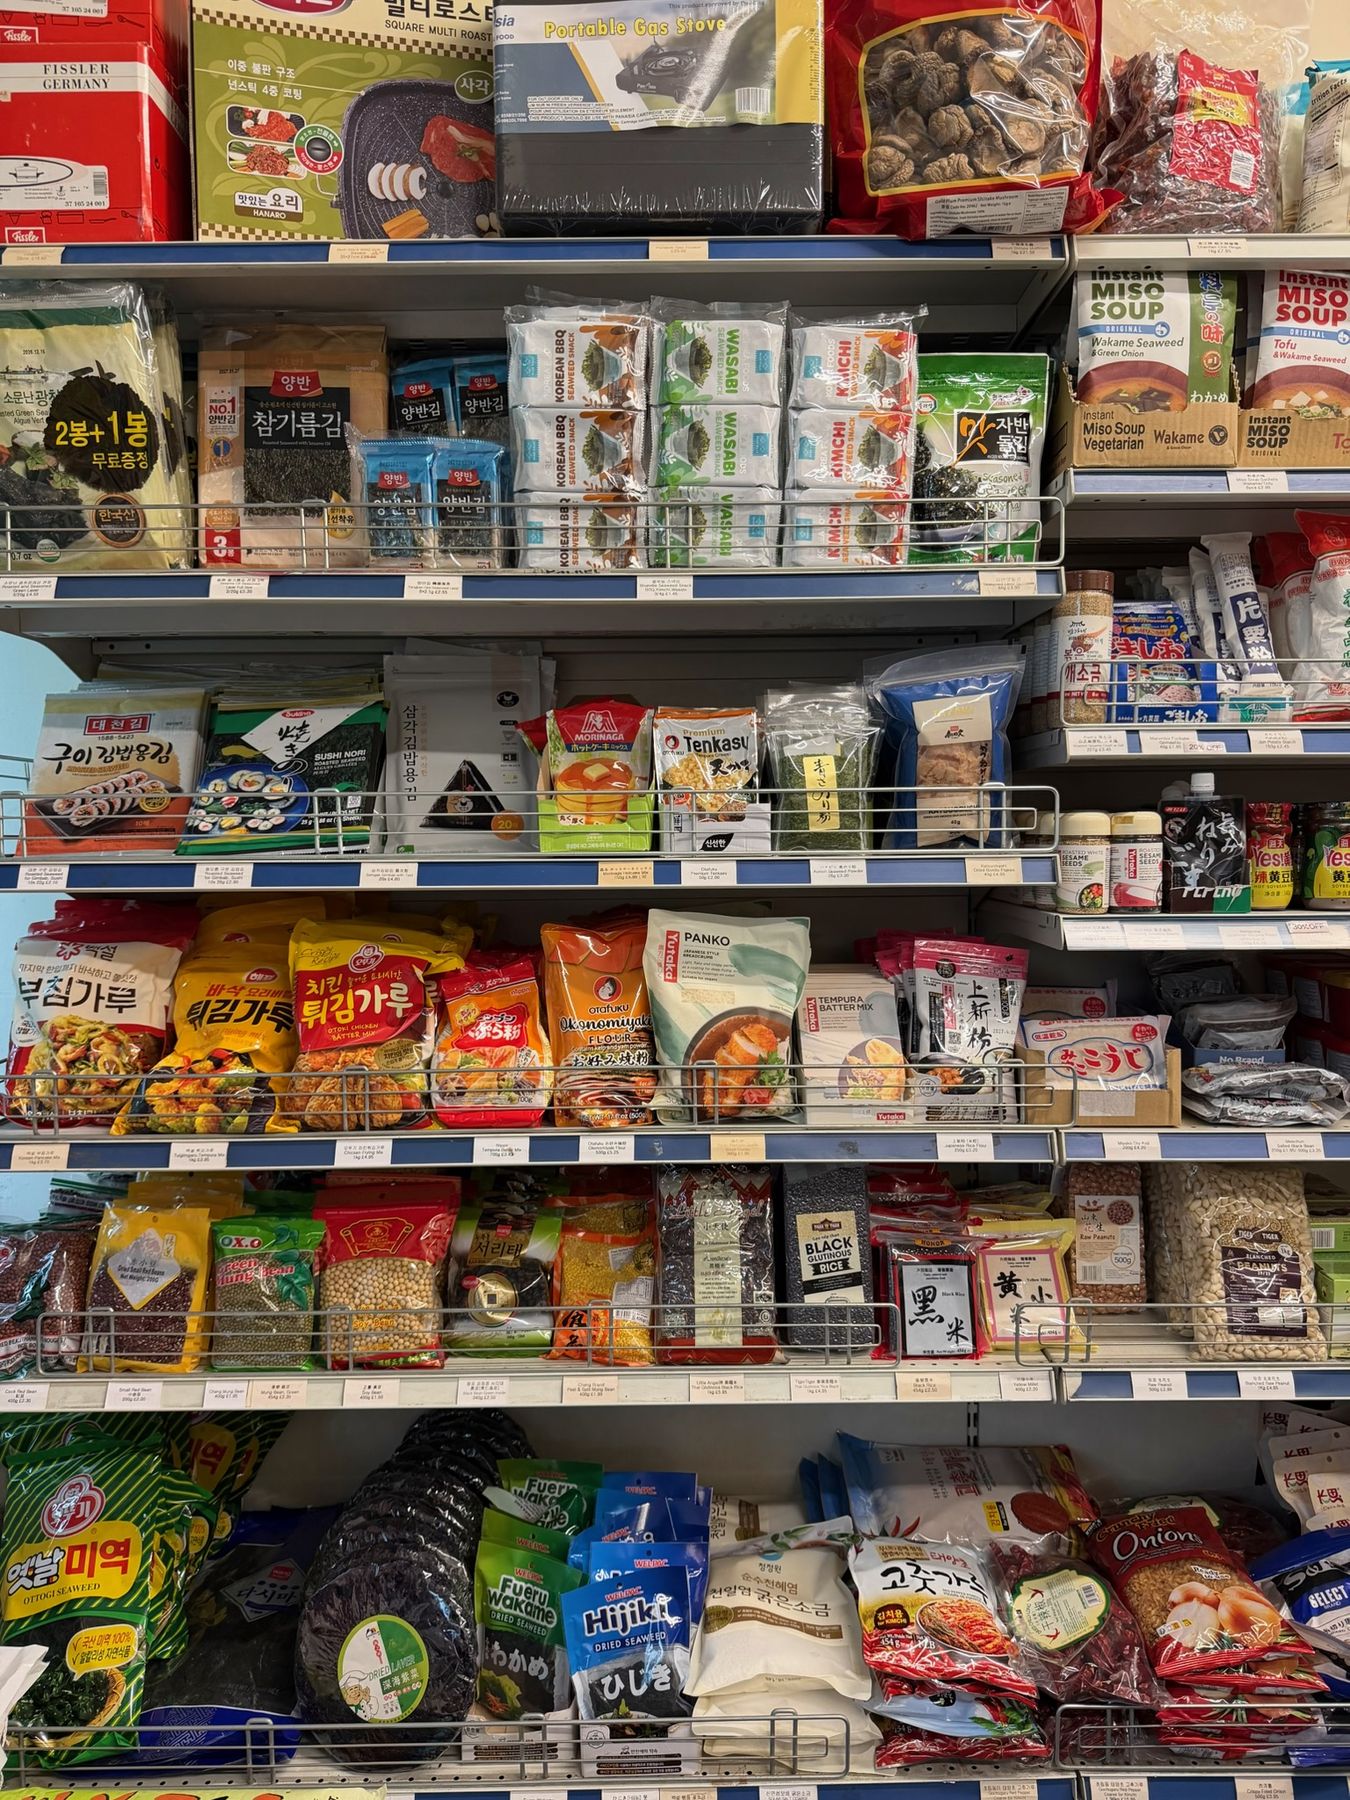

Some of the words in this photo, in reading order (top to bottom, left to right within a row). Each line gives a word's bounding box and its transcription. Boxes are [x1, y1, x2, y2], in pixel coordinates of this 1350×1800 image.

[4, 29, 32, 42] Fissler
[384, 20, 424, 33] SQUARE
[429, 26, 457, 38] MULTI
[544, 17, 627, 39] Portable
[634, 17, 669, 36] Gas
[676, 17, 726, 35] Stove
[43, 63, 110, 75] FISSLER
[228, 58, 247, 72] 이중
[252, 61, 272, 76] 불판
[276, 65, 296, 79] 구조
[42, 78, 111, 91] GERMANY
[228, 79, 258, 94] 넌스틱
[262, 83, 280, 98] 4중
[460, 78, 490, 95] 사각
[237, 194, 268, 209] 맛있는
[269, 192, 299, 211] 요리
[252, 208, 287, 220] HANARO
[12, 231, 40, 243] Fissler
[1279, 269, 1349, 289] Instant
[1091, 282, 1165, 301] MISO
[1278, 284, 1349, 308] MISO
[1090, 302, 1164, 320] SOUP
[1275, 306, 1347, 327] SOUP
[1105, 325, 1142, 333] ORIGINAL
[555, 329, 566, 355] BBQ
[1092, 336, 1134, 348] Wakame
[1136, 336, 1184, 348] Seaweed
[1273, 338, 1297, 350] Tofu
[725, 328, 740, 395] WASABI
[1120, 349, 1144, 358] Onion
[281, 375, 311, 392] 양반
[474, 376, 491, 388] 양반
[555, 358, 565, 403] KOREAN
[409, 384, 426, 395] 양반
[208, 398, 237, 415] NO.1
[402, 401, 441, 421] 양반김
[464, 394, 504, 414] 양반김
[208, 415, 236, 425] 양반김
[251, 409, 342, 438] 참기름김
[1083, 410, 1114, 421] Instant
[1249, 415, 1292, 425] Instant
[555, 414, 567, 440] BBQ
[996, 415, 1029, 434] 자반
[1083, 422, 1113, 435] Miso
[1114, 423, 1146, 438] Soup
[1247, 425, 1291, 437] MISO
[723, 412, 738, 477] WASABI
[1083, 437, 1145, 452] Vegetarian
[1153, 429, 1205, 445] Wakame
[1246, 436, 1289, 449] SOUP
[830, 421, 847, 478] KIMCHI
[92, 452, 149, 470] 무료증정
[556, 441, 567, 488] KOREAN
[384, 473, 403, 484] 양반
[454, 469, 473, 482] 양반
[98, 509, 137, 523] 한국산
[92, 715, 144, 731] 대천김
[574, 732, 625, 742] MORINAGA
[683, 736, 749, 754] Tenkasu
[42, 742, 92, 775] 구이
[96, 742, 174, 764] 김밥용김
[314, 751, 341, 761] SUSHI
[343, 749, 367, 759] NORI
[705, 838, 727, 849] 신선한
[1062, 854, 1089, 862] SESAME
[1127, 848, 1137, 878] Yutaka
[684, 931, 731, 947] PANKO
[664, 930, 681, 983] Yutaka
[17, 975, 138, 1014] 부침가루
[818, 996, 865, 1005] TEMPURA
[300, 982, 414, 1029] 튀김가루
[819, 1003, 856, 1012] BATTER
[857, 1003, 874, 1012] MIX
[806, 996, 820, 1033] Yutaka
[331, 1032, 361, 1041] BATTER
[362, 1030, 376, 1038] MIX
[588, 1034, 633, 1044] FLOUR
[876, 1112, 906, 1121] Yutaka
[475, 1240, 524, 1259] 서리태
[805, 1235, 853, 1256] BLACK
[920, 1238, 945, 1247] HONOR
[807, 1249, 852, 1264] GLUTINOUS
[1114, 1256, 1132, 1266] 500g
[819, 1261, 844, 1274] RICE
[7, 1546, 66, 1595] 옛날
[65, 1537, 131, 1579] 미역
[633, 1558, 670, 1568] WELPAC
[500, 1575, 550, 1602] Fueru
[880, 1560, 989, 1605] 고춧가루
[23, 1592, 57, 1606] OTTOGI
[57, 1582, 101, 1600] SEAWEED
[604, 1586, 644, 1602] WELPAC
[753, 1586, 832, 1618] 굵은소금
[1308, 1584, 1349, 1609] SELECT
[487, 1587, 558, 1628] Wakame
[877, 1609, 904, 1620] 김치용
[490, 1611, 515, 1625] DRIED
[516, 1617, 547, 1637] SEAWEED
[82, 1635, 97, 1648] 국산
[111, 1632, 131, 1645] 100%
[595, 1639, 623, 1652] DRIED
[624, 1631, 667, 1649] SEAWEED
[367, 1665, 391, 1681] DRIED
[391, 1654, 416, 1672] LAVER
[601, 1662, 672, 1701] ひじき
